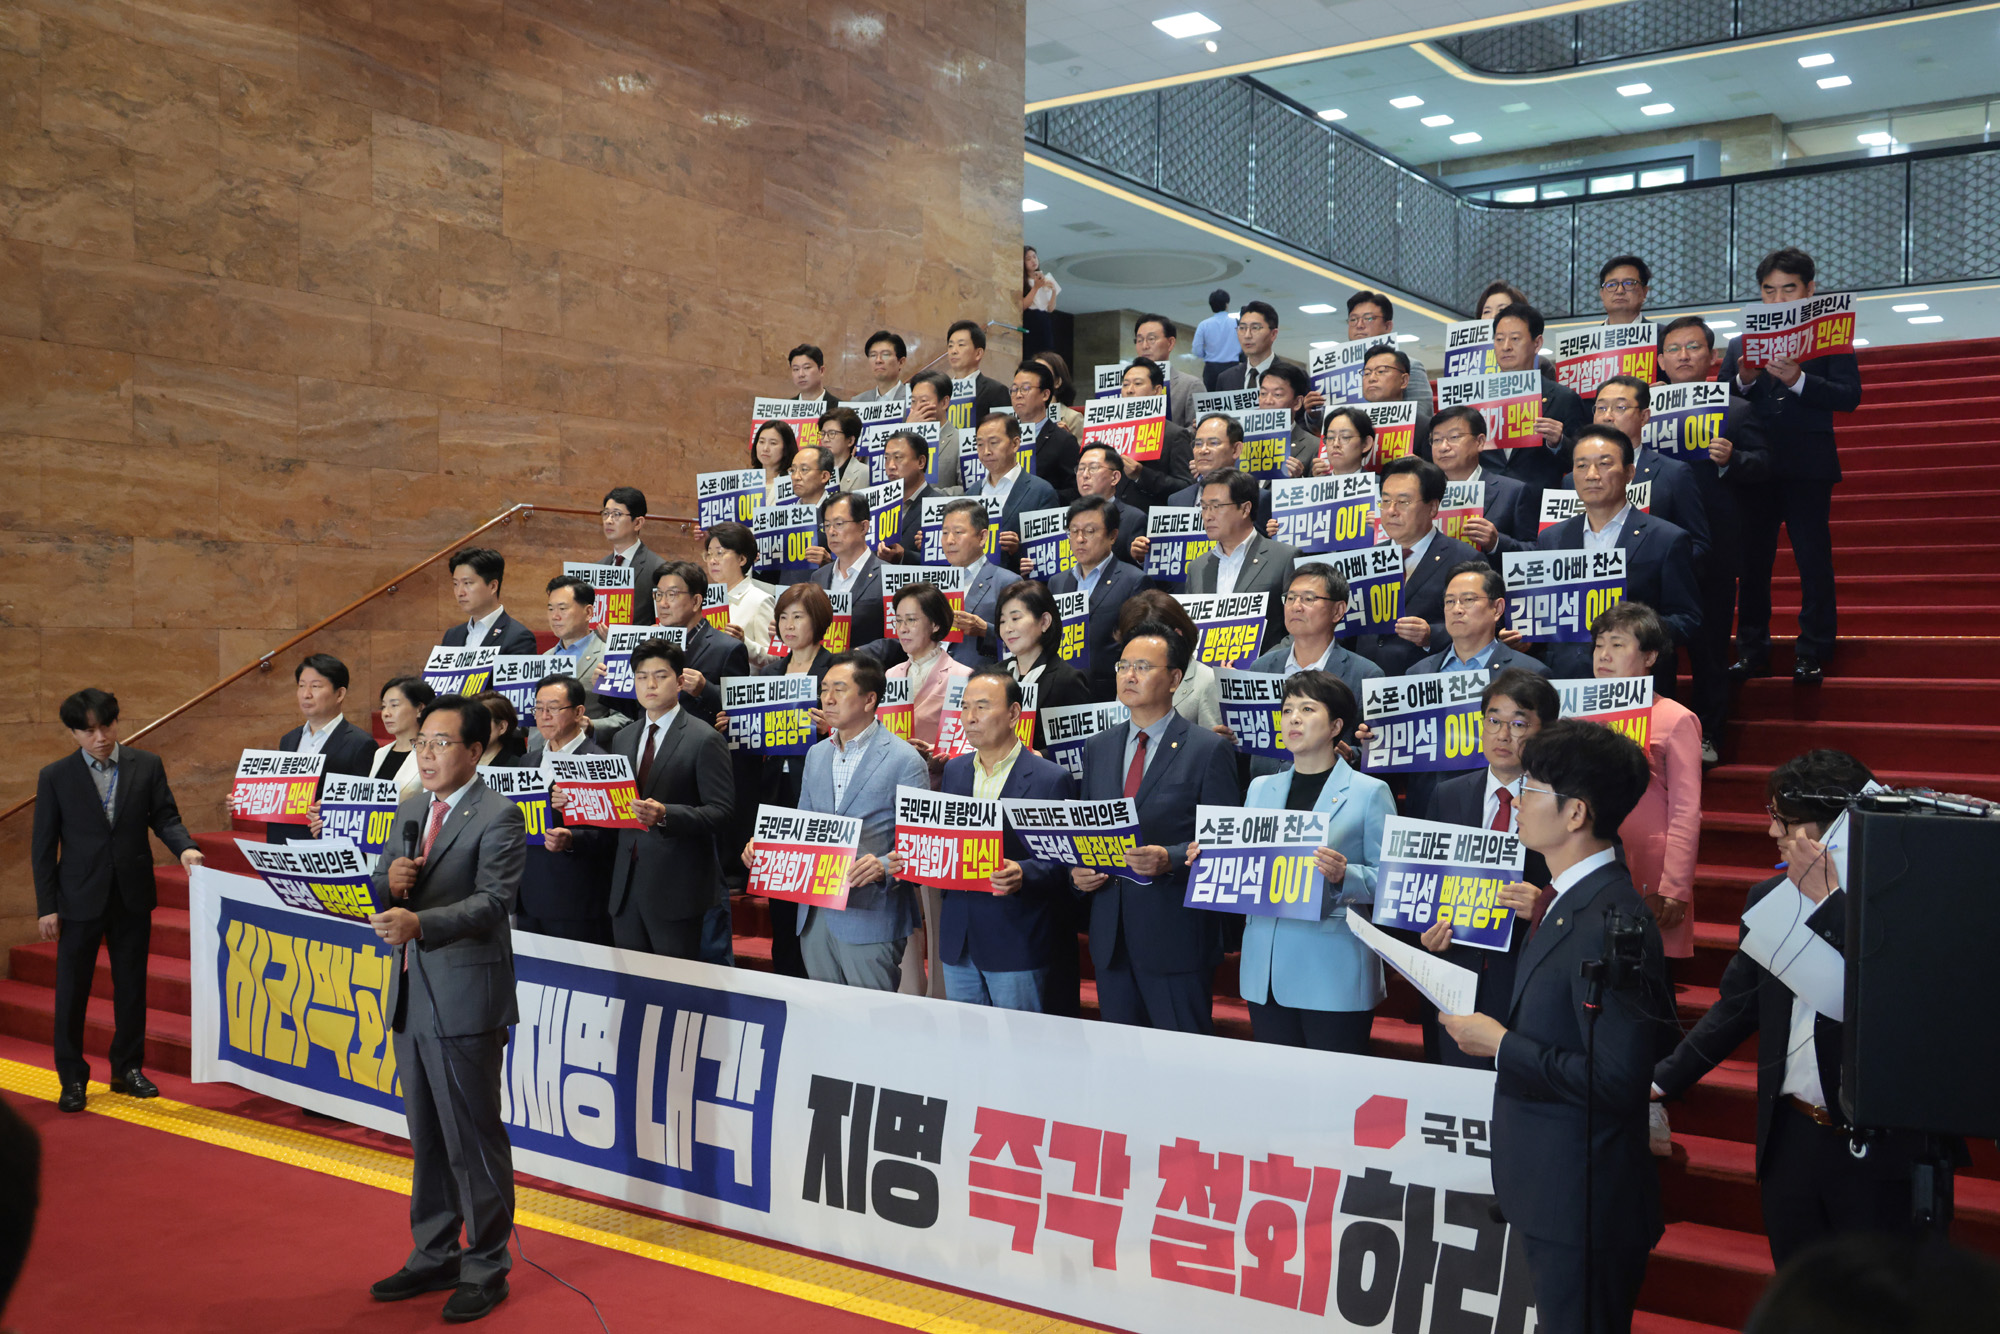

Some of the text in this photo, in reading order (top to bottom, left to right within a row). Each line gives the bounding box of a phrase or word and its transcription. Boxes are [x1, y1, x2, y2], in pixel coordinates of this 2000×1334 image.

[1746, 294, 1851, 331] 국민무시 불량인사
[1450, 325, 1489, 347] 파도파도
[1560, 325, 1652, 357] 국민무시 불량인사
[1816, 317, 1852, 350] 민심!
[1442, 372, 1535, 405] 국민무시 불량인사
[1693, 384, 1724, 406] 찬스
[756, 402, 824, 418] 국민무시 불량인사
[884, 402, 902, 418] 찬스
[1088, 397, 1162, 424] 국민무시 불량인사
[1244, 410, 1286, 431] 비리의혹
[1370, 404, 1412, 425] 불량인사
[1135, 421, 1163, 453] 민심!
[1641, 413, 1724, 454] 민석 OUT
[700, 471, 763, 496] 스폰·아빠 찬스
[883, 482, 902, 503] 찬스
[1275, 474, 1372, 508] 스폰·아빠 찬스
[1440, 484, 1479, 508] 량인사
[1627, 484, 1647, 505] 인사
[754, 507, 814, 531] 스폰·아빠 찬스
[878, 505, 901, 541] OUT
[1024, 513, 1059, 538] 파도파도
[1151, 513, 1191, 533] 파도파도
[1277, 503, 1370, 547] 김민석 OUT
[1148, 541, 1183, 576] 도덕성
[1372, 549, 1400, 574] 찬스
[1507, 551, 1623, 587] 스폰·아빠 찬스
[599, 569, 631, 587] 불량인사
[608, 594, 632, 623] 민심!
[1216, 594, 1263, 618] 비리의혹
[1369, 582, 1401, 624] OUT
[1511, 591, 1579, 637] 김민석
[1201, 624, 1259, 662] 빵점정부
[428, 651, 476, 670] 스폰·아빠
[496, 660, 546, 682] 스폰·아빠
[726, 677, 812, 706] 파도파도 비리의혹
[1220, 678, 1269, 700] 파도파도
[1367, 673, 1485, 715] 스폰·아빠 찬스
[1582, 678, 1647, 712] 불량인사
[728, 708, 812, 750] 도덕성 빵점정부
[1048, 711, 1094, 741] 파도파도
[1367, 717, 1438, 768] 김민석
[241, 756, 321, 775] 국민무시 불량인사
[552, 758, 628, 780] 국민무시 불량인사
[324, 782, 398, 803] 스폰·아빠 찬스
[517, 770, 544, 792] 찬스
[234, 782, 316, 816] 즉각철회가 민심!
[900, 797, 997, 827] 국민무시 불량인사
[1011, 801, 1130, 827] 파도파도 비리의혹
[321, 810, 394, 844] 김민석 OUT
[757, 815, 856, 844] 국민무시 불량인사
[1198, 814, 1324, 845] 스폰·아빠 찬스
[248, 849, 360, 874] 파도파도 비리의혹
[898, 832, 999, 880] 즉각철회가 민심!
[1024, 834, 1078, 865] 도덕성
[1388, 830, 1519, 866] 파도파도 비리의혹
[749, 849, 852, 897] 즉각철회가 민심!
[1190, 855, 1319, 905] 김민석 OUT
[267, 876, 377, 919] 도덕성 빵점정부
[1380, 871, 1438, 923] 도덕성
[500, 980, 625, 1149] 재명
[636, 1003, 765, 1187] 내각
[802, 1074, 948, 1229] 지명
[968, 1106, 1131, 1271] 즉각
